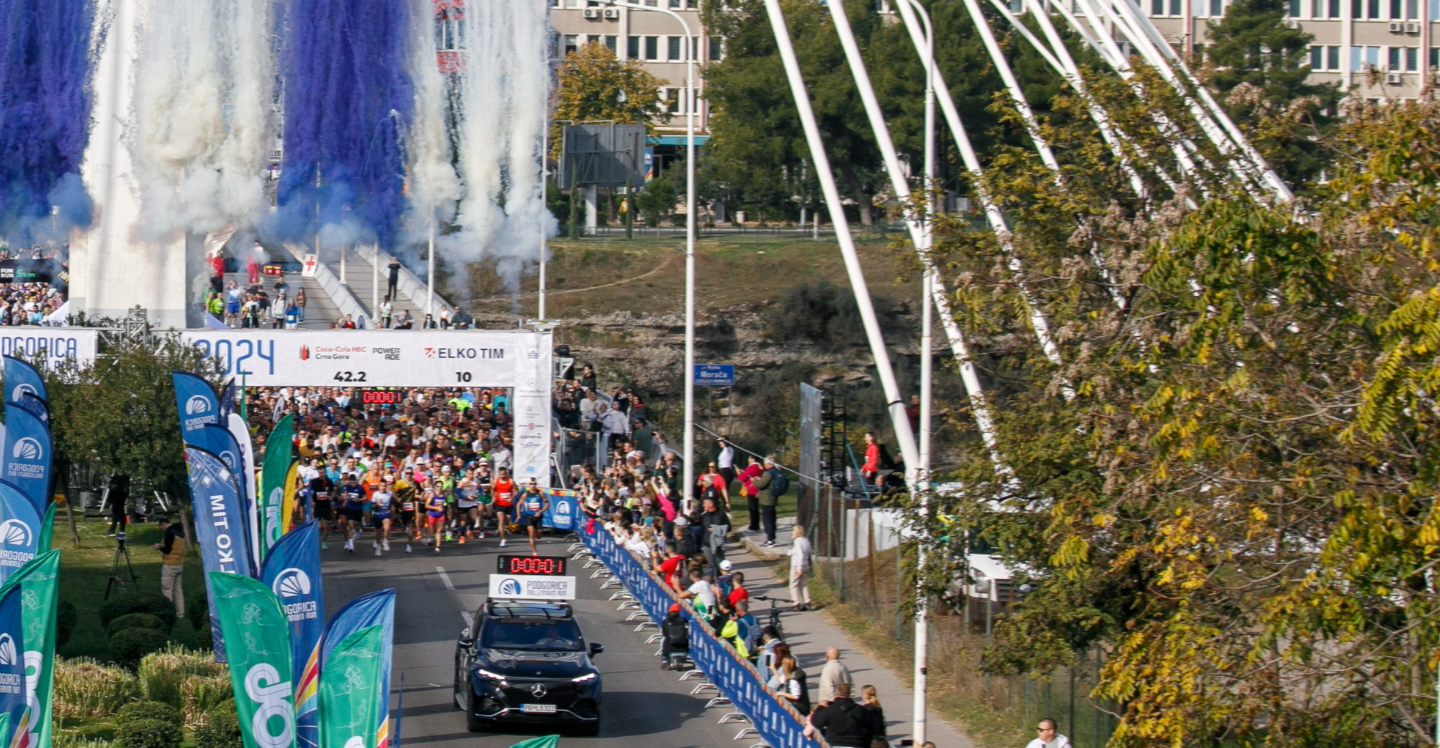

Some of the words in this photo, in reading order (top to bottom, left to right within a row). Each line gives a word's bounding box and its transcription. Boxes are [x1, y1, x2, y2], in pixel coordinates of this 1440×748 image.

[194, 339, 274, 375] 2024
[438, 348, 477, 359] ELKO
[479, 348, 504, 359] TIM
[333, 371, 367, 382] 42.2
[455, 371, 472, 382] 10
[700, 370, 728, 378] Morača
[363, 391, 402, 404] 0:00:01
[510, 557, 563, 574] 0:00:01
[526, 580, 568, 589] PODGORICA
